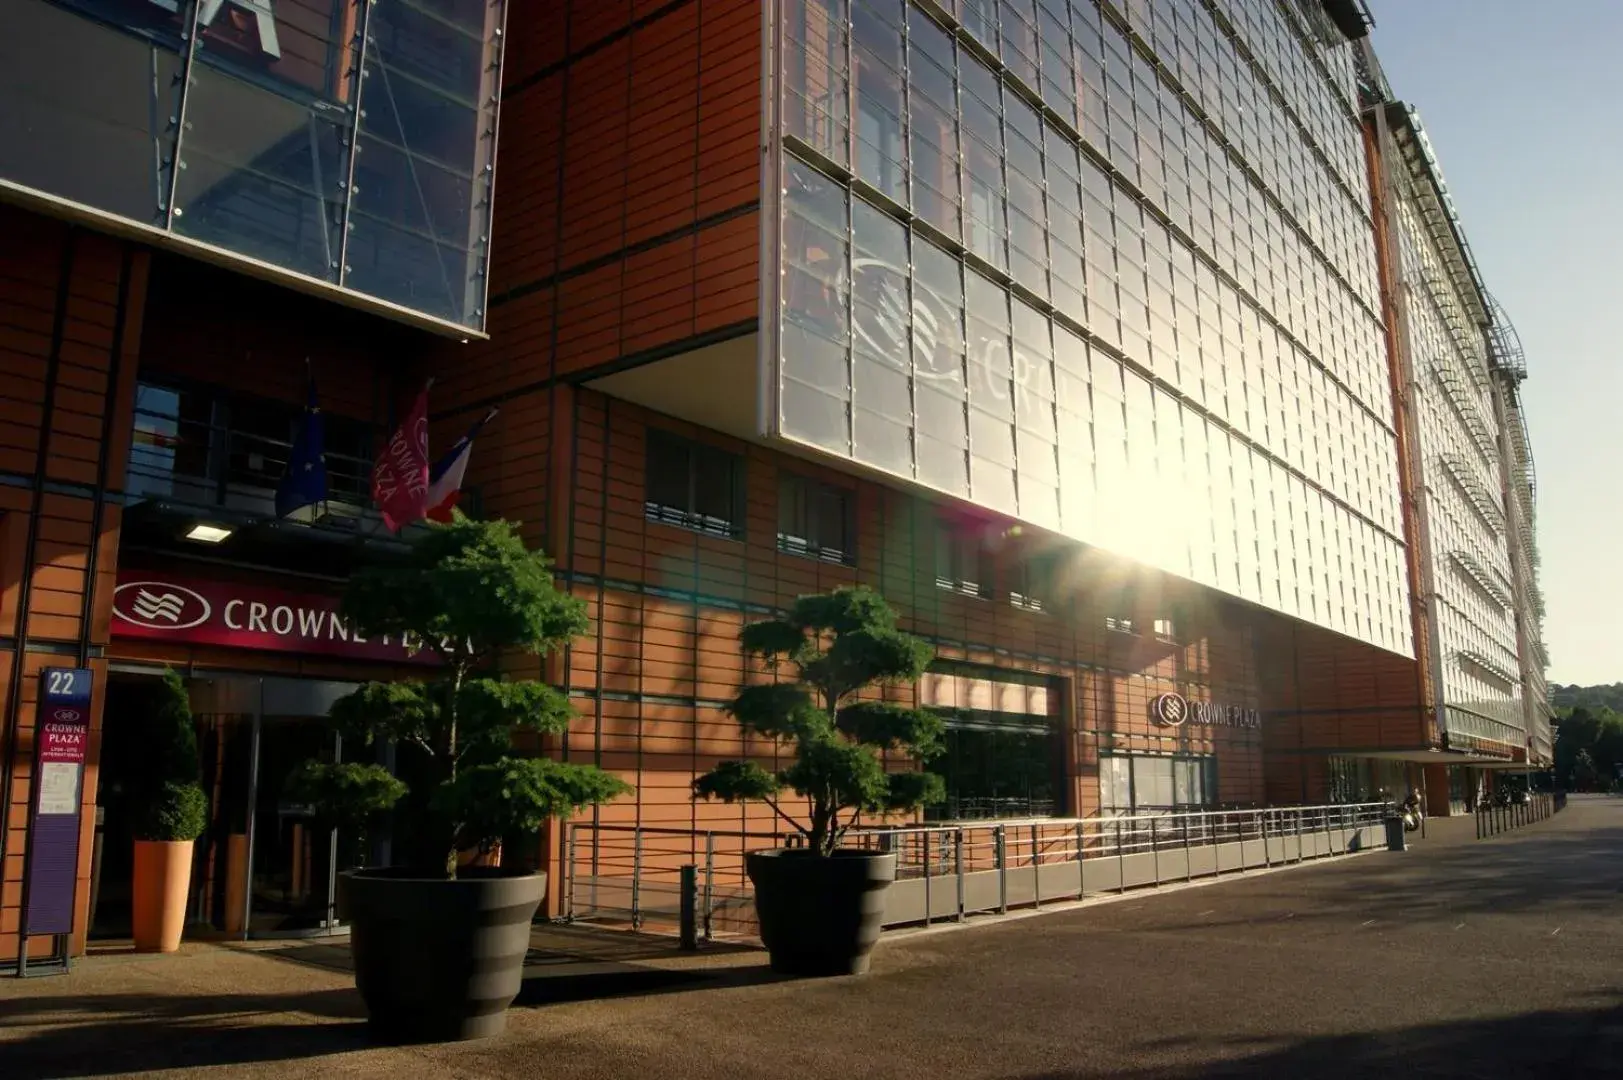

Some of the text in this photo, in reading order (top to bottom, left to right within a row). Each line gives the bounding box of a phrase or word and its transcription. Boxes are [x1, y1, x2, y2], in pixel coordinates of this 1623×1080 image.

[49, 671, 74, 695] 22
[1190, 700, 1231, 726] CROWNE
[44, 722, 87, 734] CROWNE
[49, 733, 81, 745] PLAZA
